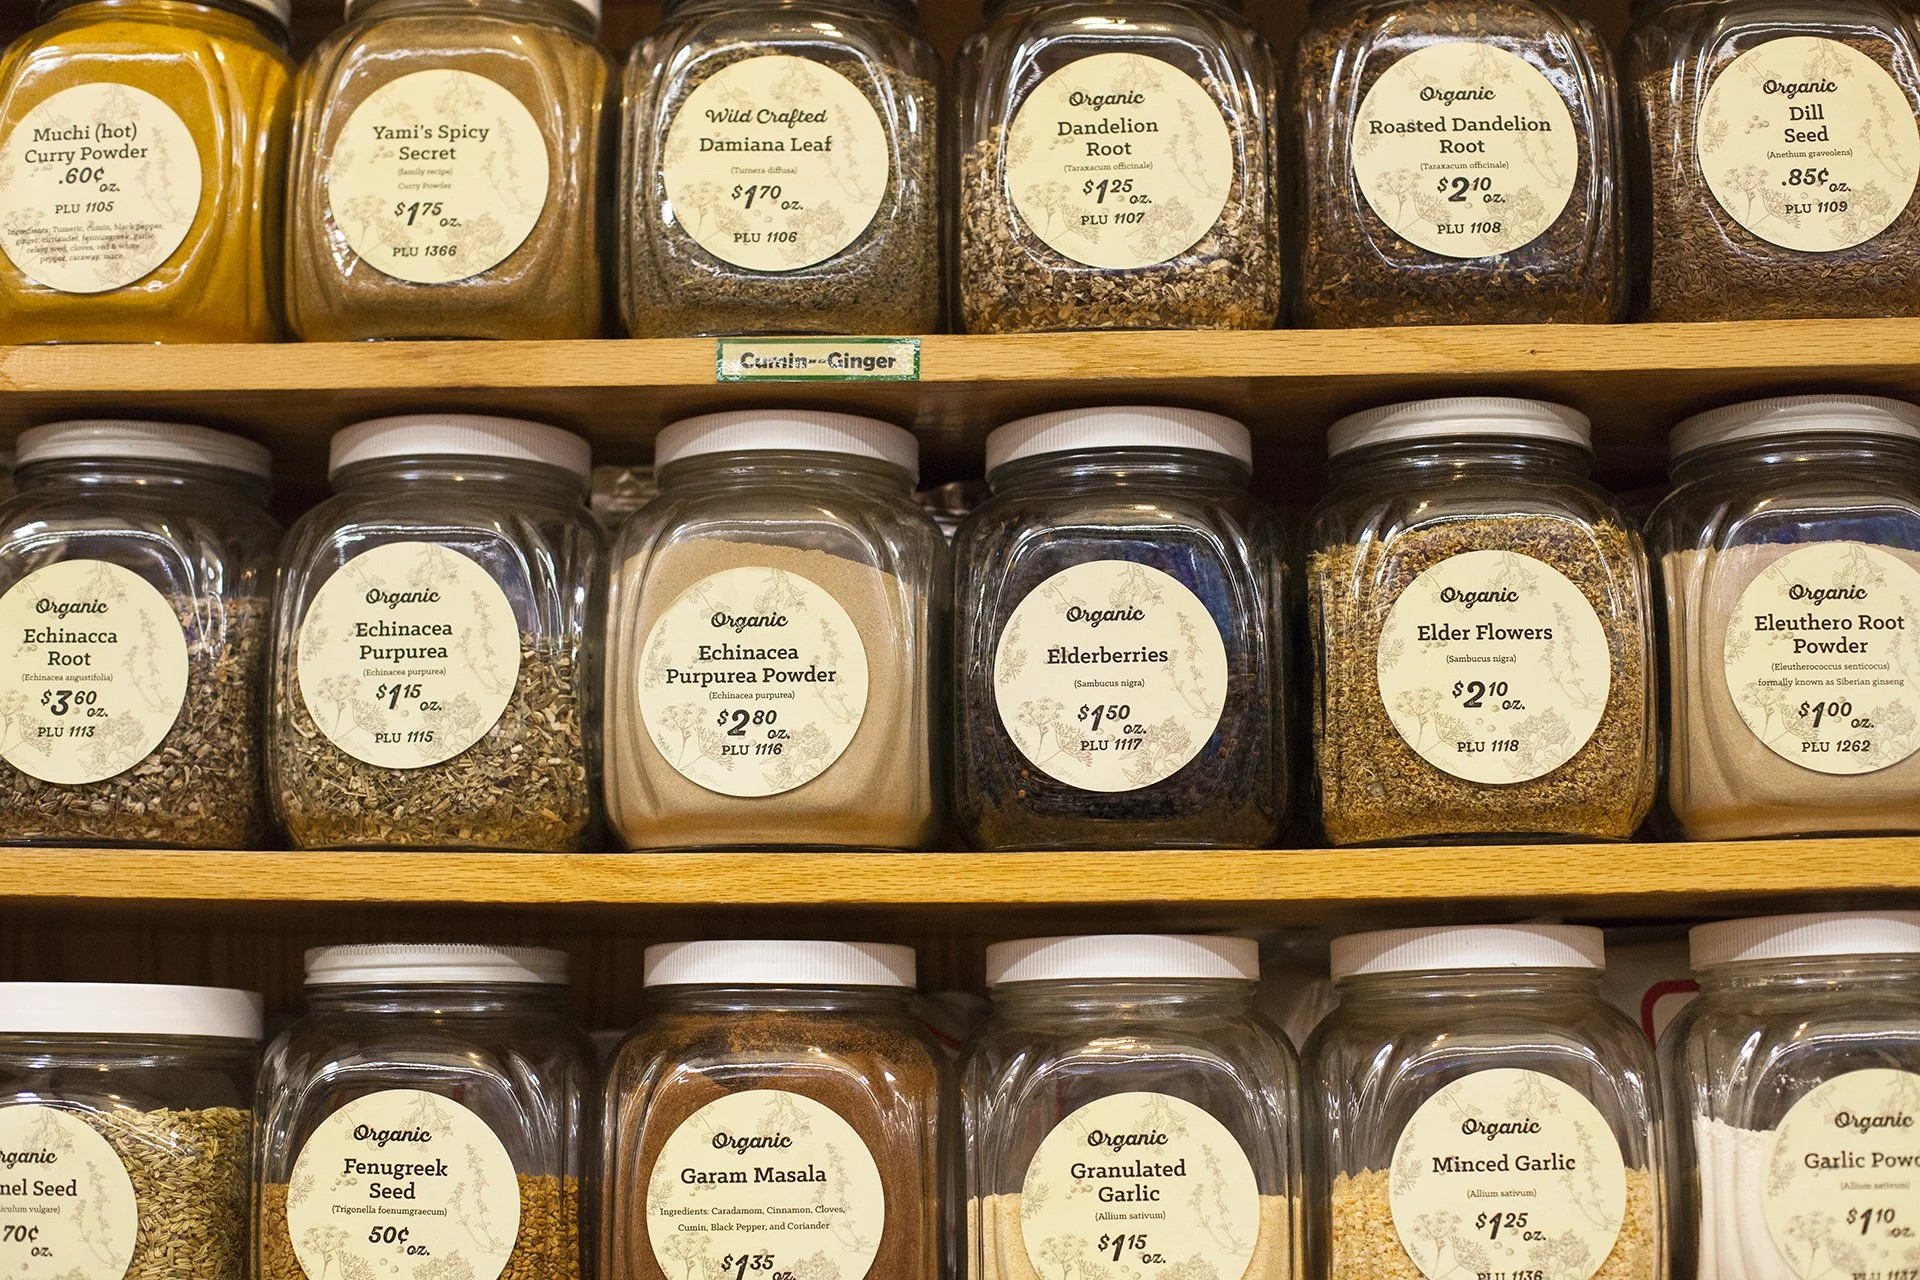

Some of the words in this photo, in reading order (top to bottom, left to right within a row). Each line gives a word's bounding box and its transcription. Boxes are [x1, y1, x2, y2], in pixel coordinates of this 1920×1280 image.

[1762, 78, 1839, 100] Organic
[1069, 90, 1146, 111] Organic
[1419, 86, 1496, 107] Organic
[705, 108, 753, 124] Wild
[756, 108, 828, 129] Crafted
[1789, 104, 1825, 121] Dill
[1057, 117, 1159, 136] Dandelion
[1369, 116, 1447, 135] Roasted
[1451, 115, 1552, 132] Dandelion
[33, 125, 90, 142] Muchi
[95, 122, 137, 143] (hot)
[438, 124, 490, 143] Spicy
[1784, 125, 1830, 143] Seed
[699, 137, 785, 153] Damiana
[790, 135, 833, 152] Leaf
[1086, 141, 1132, 157] Root
[1439, 139, 1486, 154] Root
[24, 149, 76, 166] Curry
[80, 143, 148, 161] Powder
[399, 146, 457, 161] Secret
[1766, 150, 1807, 160] (Anethum
[1808, 148, 1853, 159] graveolens)
[1063, 164, 1112, 173] (Taraxacum
[1113, 161, 1153, 171] officinale)
[1420, 162, 1468, 172] (Taraxacum
[1469, 160, 1510, 170] officinale)
[99, 183, 120, 192] oz.
[1828, 182, 1852, 192] oz.
[1129, 194, 1153, 204] oz.
[1482, 193, 1506, 203] oz.
[55, 204, 81, 214] PLU
[85, 201, 114, 213] 1105
[781, 200, 804, 211] oz.
[1784, 203, 1812, 214] PLU
[1817, 201, 1849, 213] 1109
[440, 217, 462, 227] oz.
[1081, 214, 1108, 226] PLU
[1114, 212, 1146, 224] 1107
[1436, 223, 1465, 235] PLU
[1470, 221, 1502, 234] 1108
[733, 232, 761, 243] PLU
[766, 231, 798, 243] 1106
[392, 247, 419, 257] PLU
[424, 245, 458, 256] 1366
[365, 588, 442, 610] Organic
[1440, 586, 1520, 609] Organic
[1788, 583, 1868, 606] Organic
[35, 598, 109, 620] Organic
[710, 611, 789, 633] Organic
[1066, 605, 1146, 628] Organic
[1754, 613, 1853, 632] Eleuthero
[1858, 614, 1905, 630] Root
[355, 620, 453, 637] Echinacea
[1417, 623, 1471, 642] Elder
[1475, 622, 1553, 641] Flowers
[698, 643, 800, 661] Echinacea
[1793, 636, 1869, 654] Powder
[47, 651, 92, 666] Root
[359, 645, 449, 664] Purpurea
[1047, 645, 1169, 665] Elderberries
[1445, 655, 1491, 664] (Sambucus
[1492, 654, 1517, 664] nigra)
[362, 668, 406, 677] (Echinacea
[407, 667, 447, 677] purpurea)
[1771, 662, 1843, 672] (Eleutherococcus
[21, 673, 64, 682] (Echinacea
[64, 673, 114, 683] angustifolia)
[665, 669, 757, 688] Purpurea
[762, 665, 837, 683] Powder
[1757, 678, 1793, 688] formally
[1794, 678, 1824, 686] known
[1836, 677, 1871, 686] Siberian
[1872, 678, 1905, 687] ginseng
[1073, 679, 1119, 689] (Sambucus
[1120, 679, 1145, 688] nigra)
[708, 691, 754, 701] (Echinacea
[755, 691, 796, 701] purpurea)
[419, 701, 443, 711] oz.
[1502, 699, 1526, 711] oz.
[86, 707, 109, 718] oz.
[1123, 724, 1147, 735] oz.
[1851, 717, 1875, 729] oz.
[37, 726, 64, 738] PLU
[69, 726, 96, 738] 1113
[374, 732, 402, 744] PLU
[407, 730, 434, 743] 1115
[767, 729, 791, 740] oz.
[721, 745, 750, 756] PLU
[755, 743, 783, 755] 1116
[1080, 740, 1109, 751] PLU
[1114, 738, 1143, 751] 1117
[1457, 741, 1485, 753] PLU
[1491, 739, 1519, 752] 1118
[1801, 741, 1830, 753] PLU
[1836, 739, 1871, 753] 1262
[1461, 1118, 1542, 1141] Organic
[1834, 1111, 1915, 1135] Organic
[353, 1123, 433, 1148] Organic
[1087, 1129, 1169, 1153] Organic
[711, 1131, 793, 1155] Organic
[1432, 1154, 1510, 1173] Minced
[1515, 1152, 1576, 1172] Garlic
[1804, 1151, 1866, 1169] Garlic
[343, 1158, 448, 1180] Fenugreek
[681, 1168, 749, 1185] Garam
[753, 1164, 827, 1183] Masala
[1070, 1158, 1187, 1179] Granulated
[32, 1179, 78, 1197] Seed
[369, 1182, 416, 1200] Seed
[1098, 1184, 1161, 1203] Garlic
[1466, 1189, 1499, 1199] (Allium
[1500, 1188, 1537, 1198] sativum)
[331, 1204, 377, 1215] (Trigonella
[378, 1205, 448, 1217] foenumgraecum)
[660, 1207, 710, 1217] Ingredients:
[711, 1206, 765, 1216] Caradamom,
[766, 1206, 814, 1215] Cinnamon,
[814, 1205, 846, 1214] Cloves,
[1095, 1211, 1128, 1222] (Allium
[1129, 1210, 1167, 1221] sativum)
[677, 1223, 709, 1233] Cumin,
[710, 1222, 734, 1232] Black
[735, 1222, 768, 1233] Pepper,
[769, 1222, 786, 1231] and
[787, 1221, 830, 1231] Coriander
[1522, 1230, 1547, 1242] oz.
[30, 1246, 53, 1257] oz.
[406, 1245, 431, 1256] oz.
[1141, 1253, 1167, 1264] oz.
